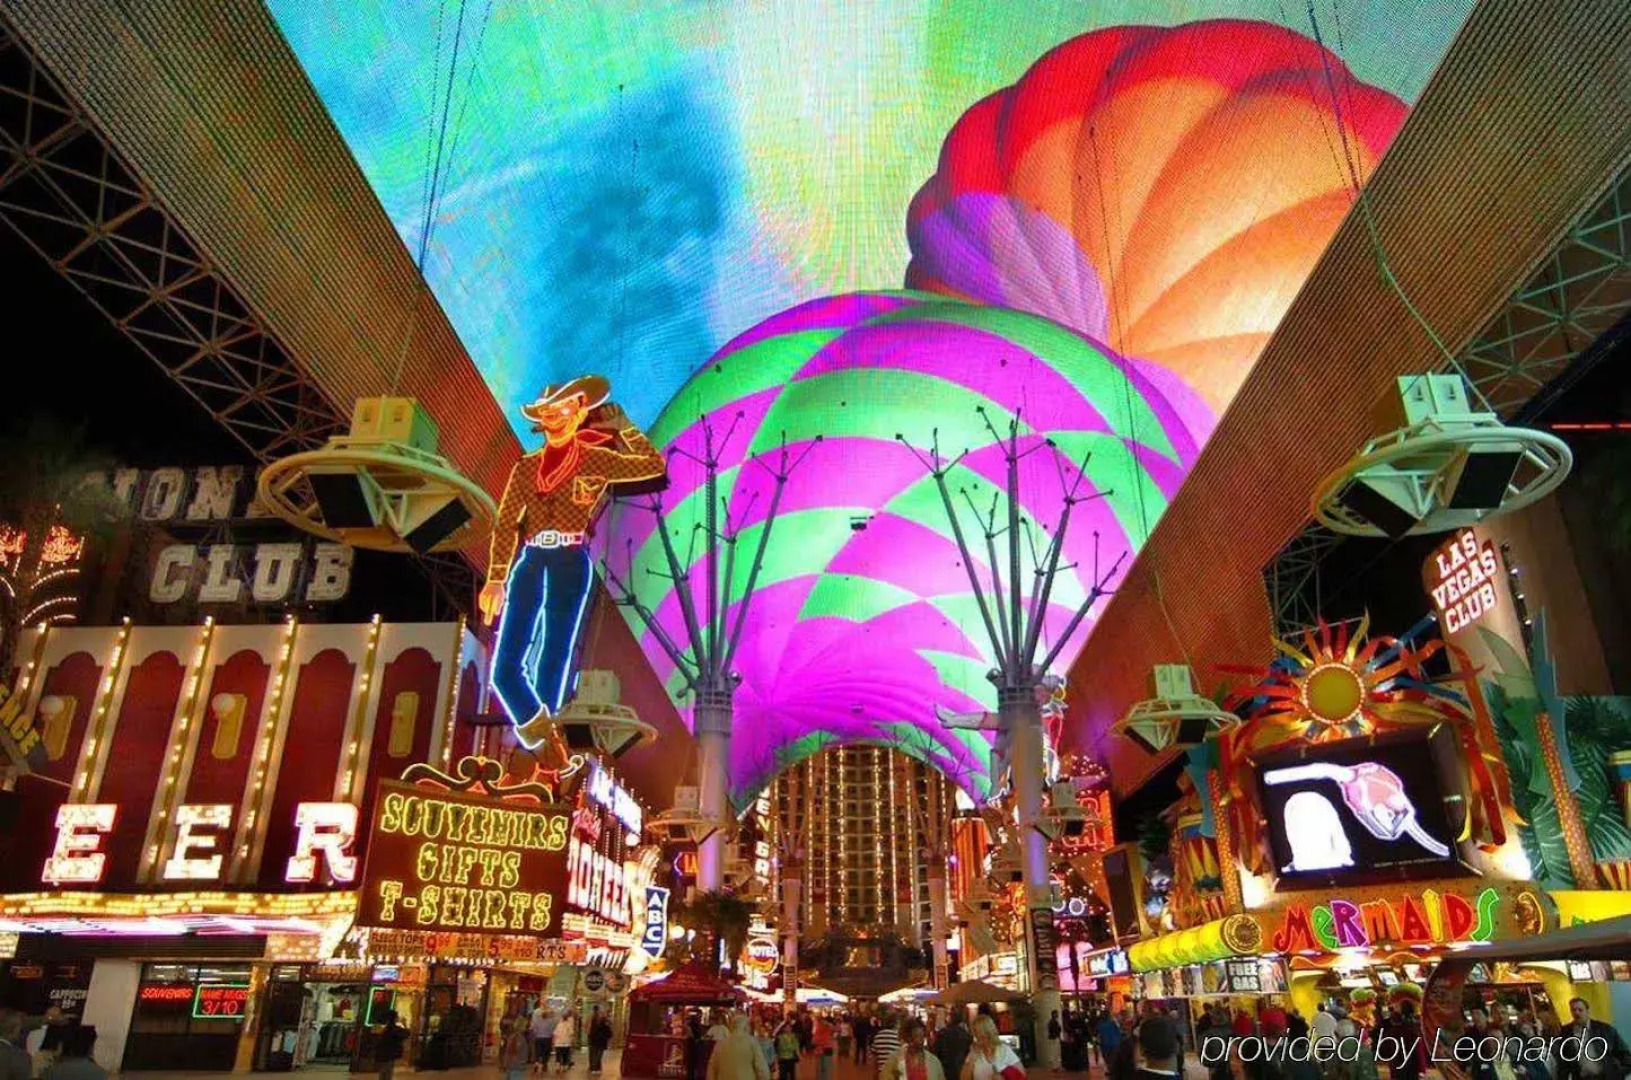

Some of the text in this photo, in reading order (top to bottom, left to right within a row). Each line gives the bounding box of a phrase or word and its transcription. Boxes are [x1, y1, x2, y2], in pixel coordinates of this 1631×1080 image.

[149, 542, 354, 603] CLUB
[1431, 548, 1497, 610] VEGAS
[1436, 530, 1478, 579] LAS
[1445, 582, 1496, 634] CLUB
[380, 792, 569, 851] SOUVENIRS
[416, 842, 521, 888] GIFTS
[380, 880, 553, 930] T-SHIRTS
[645, 891, 664, 942] ABC
[1229, 962, 1258, 976] FREE
[1232, 976, 1259, 991] GAS
